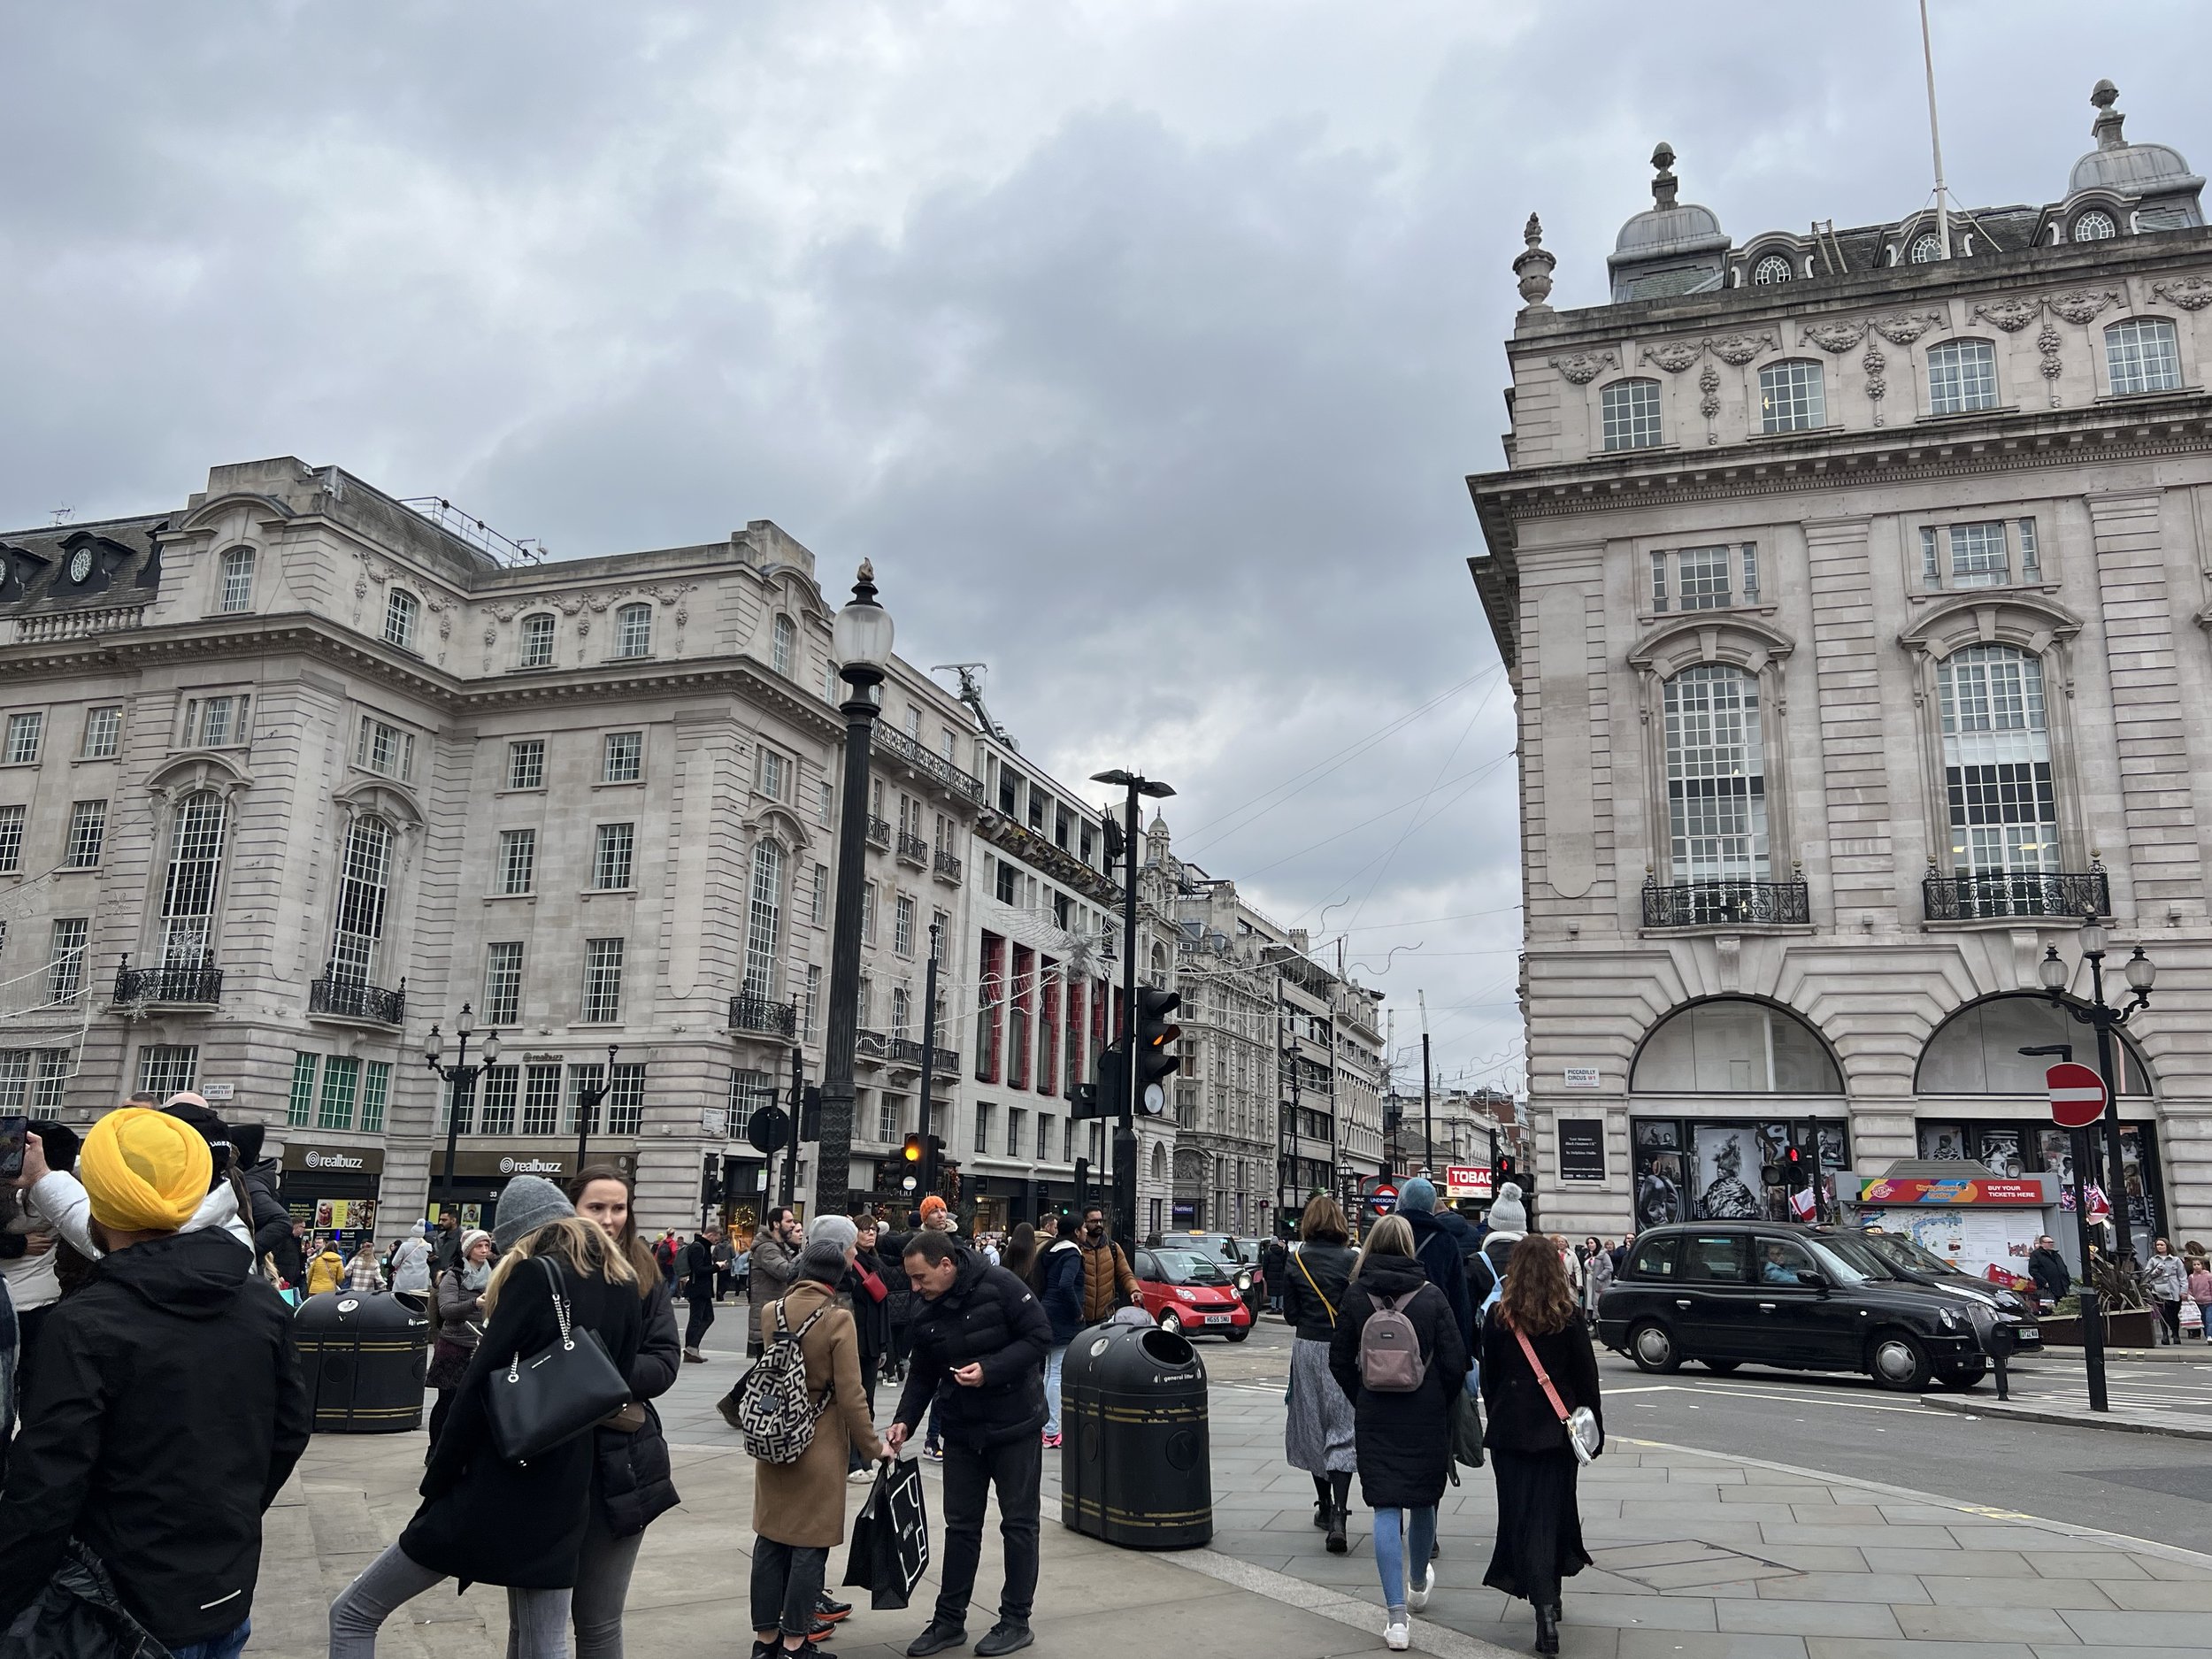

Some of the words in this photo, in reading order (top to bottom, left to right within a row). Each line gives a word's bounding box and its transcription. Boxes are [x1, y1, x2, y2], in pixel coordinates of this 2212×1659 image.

[319, 1154, 363, 1168] realbuzz
[514, 1158, 562, 1172] realbuzz
[1451, 1171, 1492, 1185] TOBAC
[1164, 1373, 1184, 1383] general
